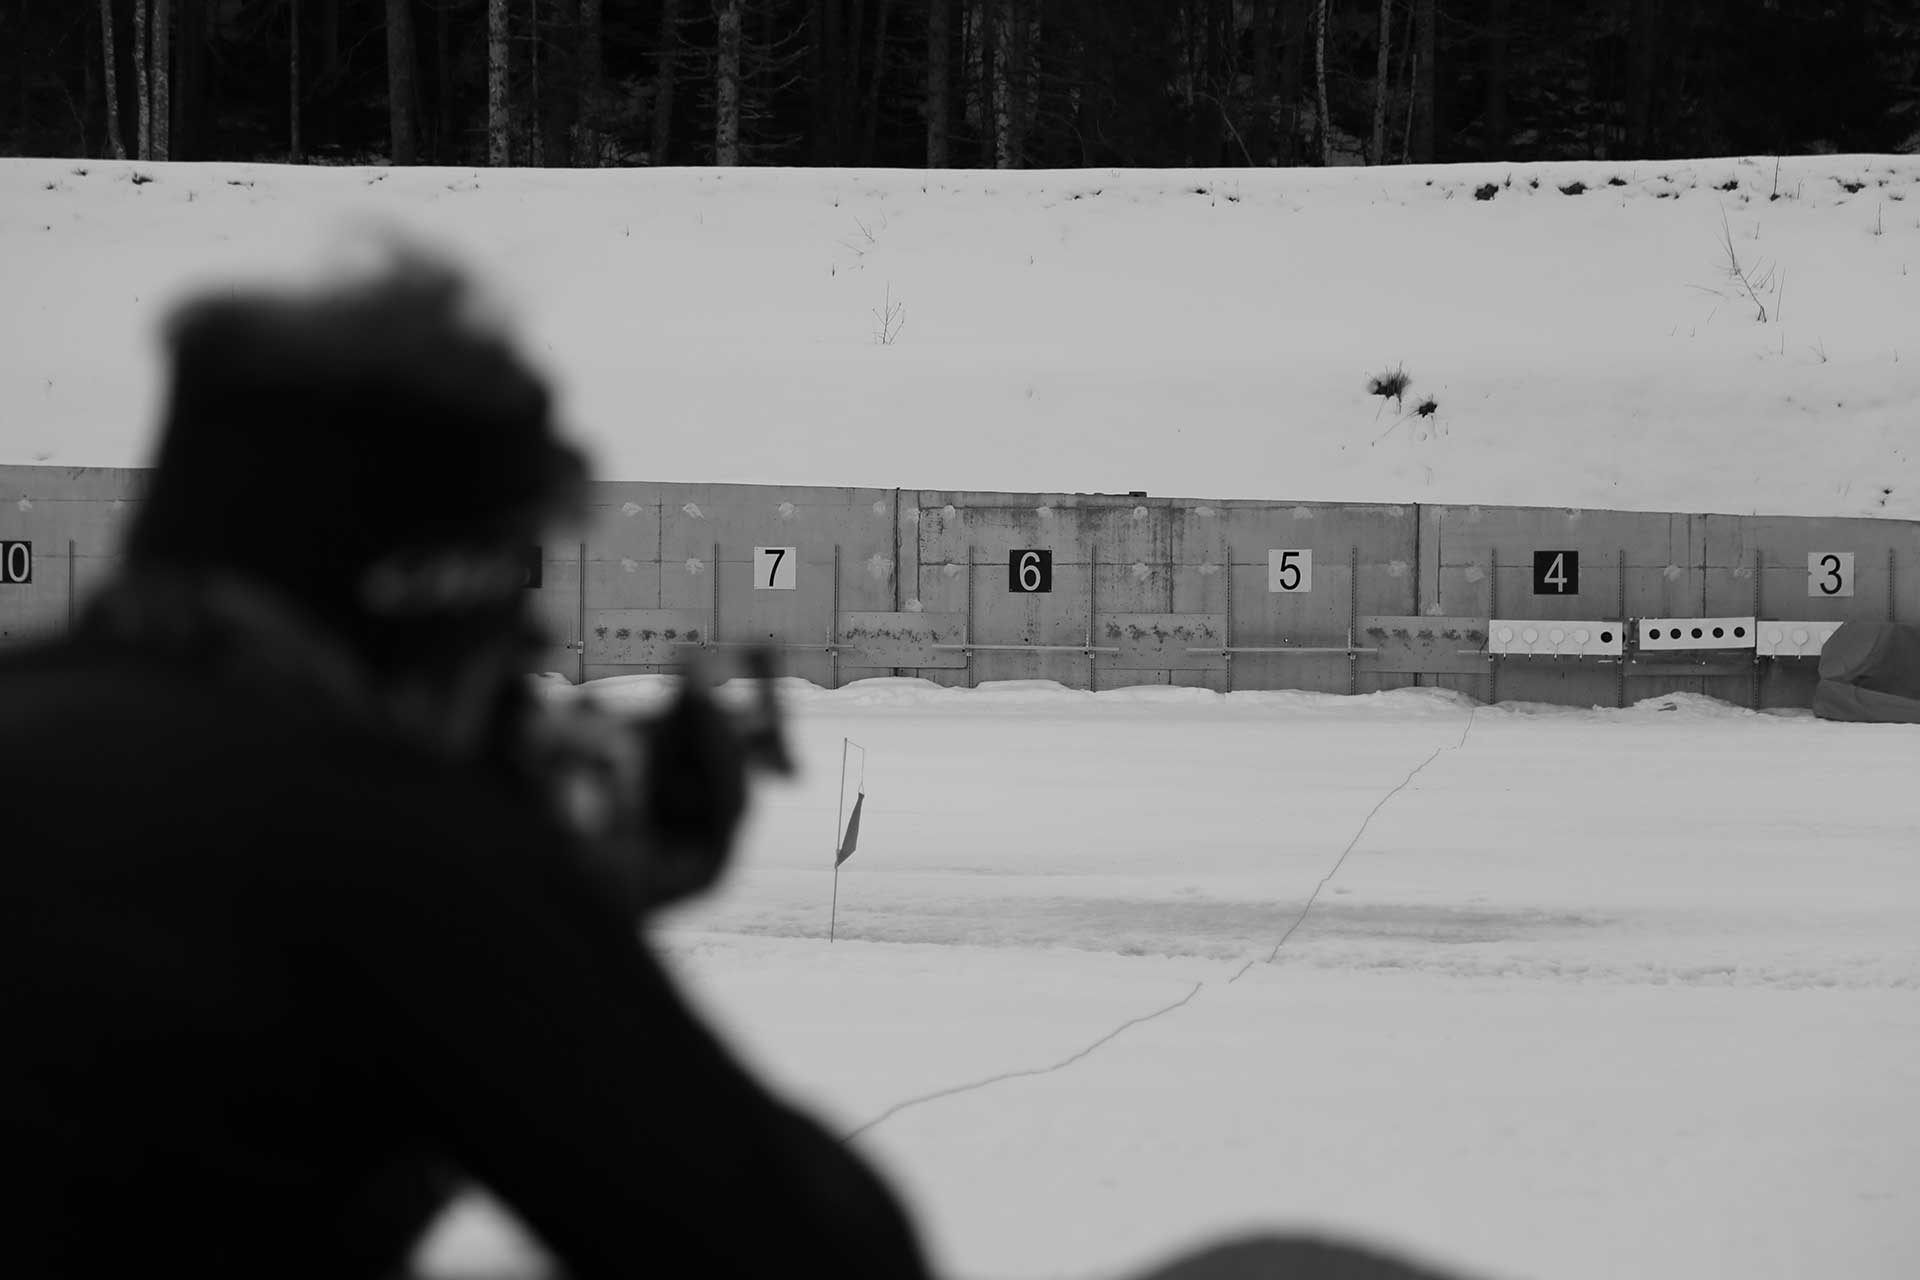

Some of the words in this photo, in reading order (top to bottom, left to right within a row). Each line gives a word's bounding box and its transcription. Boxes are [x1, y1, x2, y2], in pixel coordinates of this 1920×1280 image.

[764, 550, 787, 587] 7
[1019, 551, 1041, 591] 6
[1279, 551, 1302, 589] 5
[1543, 552, 1568, 592] 4
[1818, 554, 1843, 594] 3
